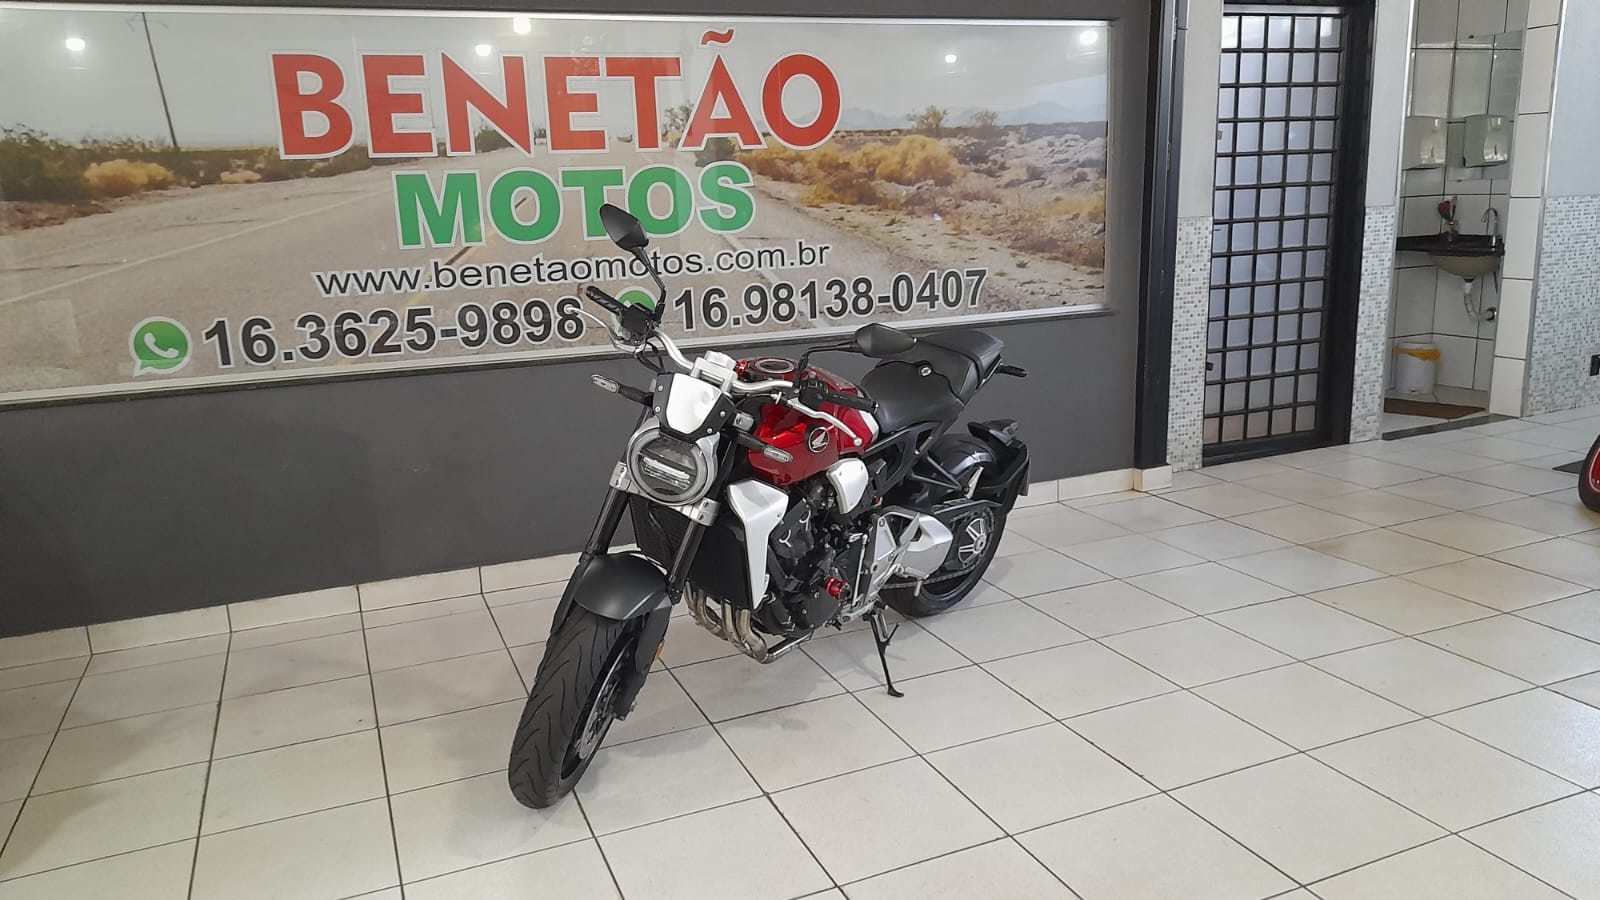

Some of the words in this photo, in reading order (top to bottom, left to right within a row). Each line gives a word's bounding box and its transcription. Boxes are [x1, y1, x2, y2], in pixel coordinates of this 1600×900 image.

[272, 29, 840, 158] BENETÃO
[394, 163, 755, 247] MOTOS
[316, 242, 829, 296] www.benetaomotos.com.br
[205, 299, 583, 366] 16.3625-9898
[675, 270, 986, 330] 16.98138-0407
